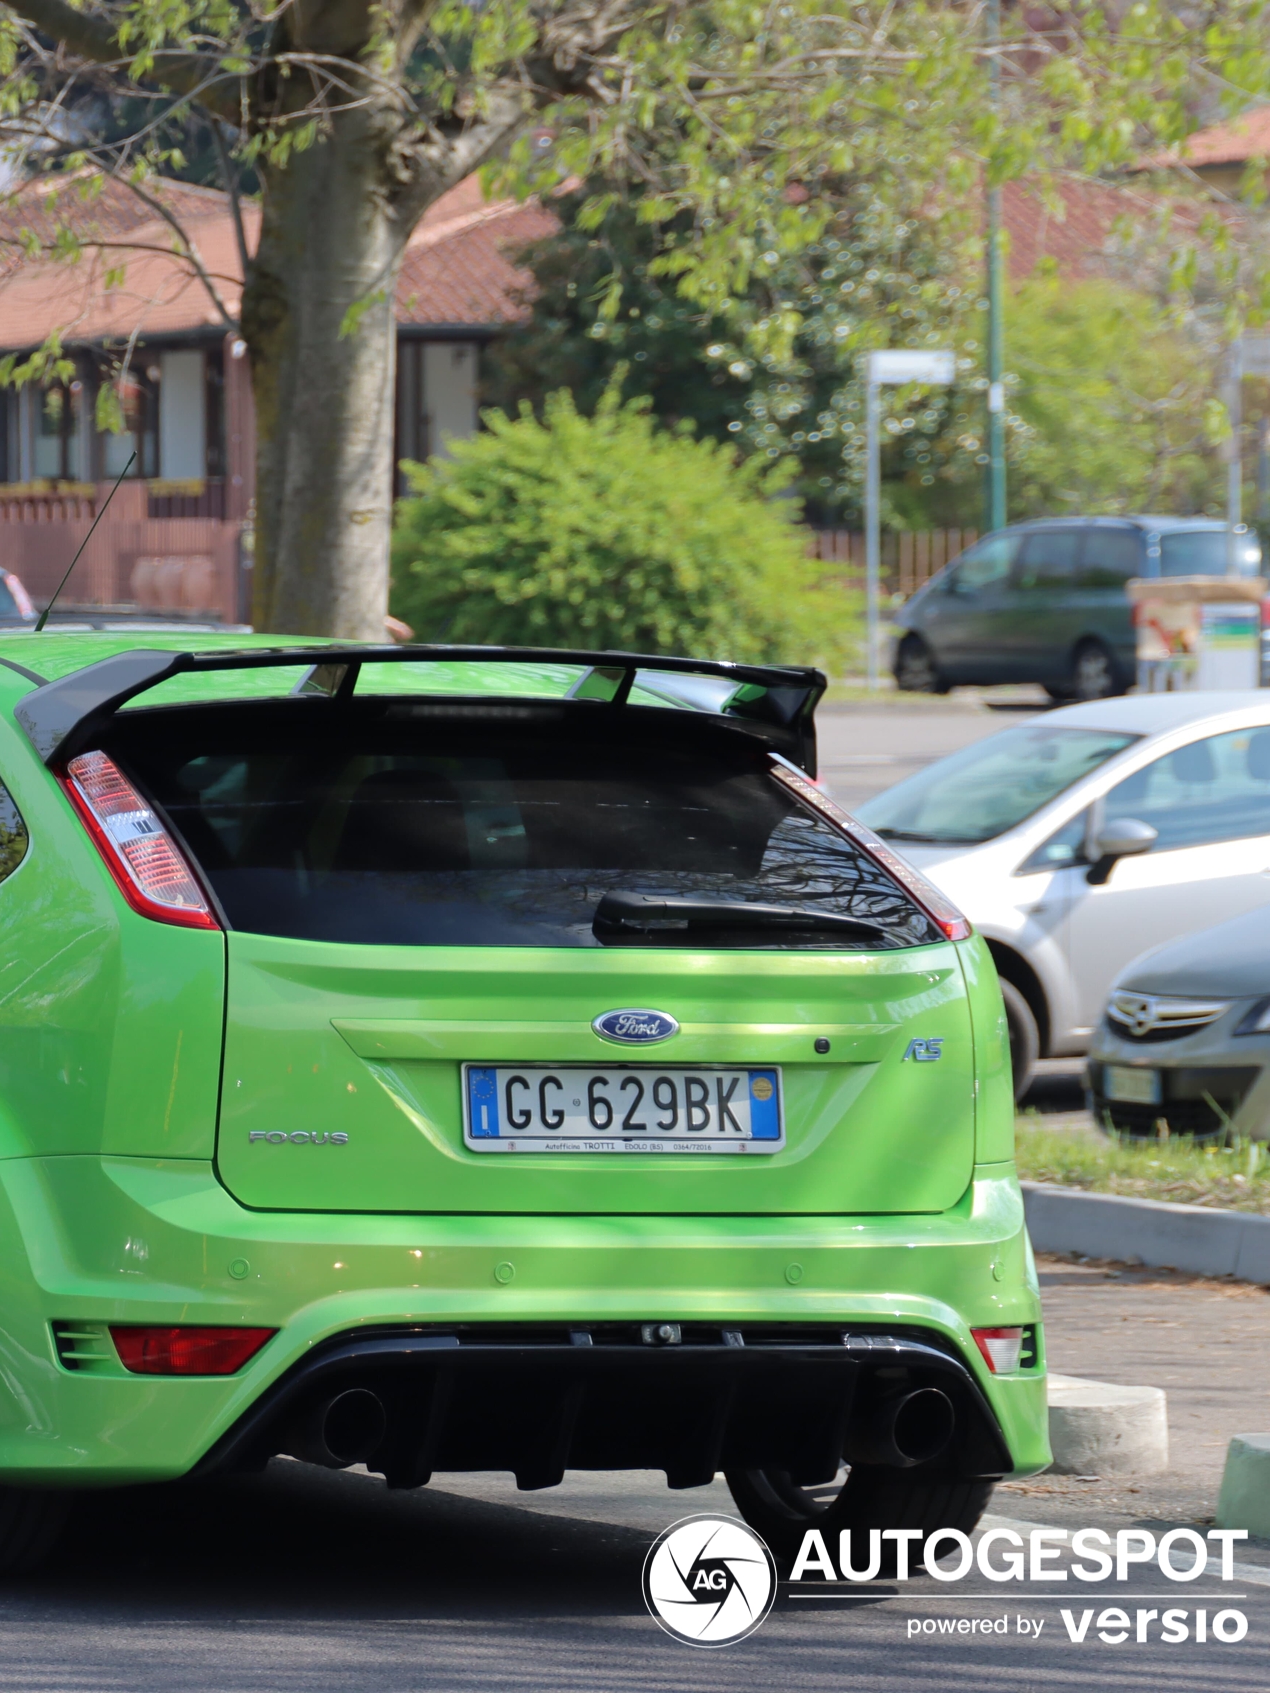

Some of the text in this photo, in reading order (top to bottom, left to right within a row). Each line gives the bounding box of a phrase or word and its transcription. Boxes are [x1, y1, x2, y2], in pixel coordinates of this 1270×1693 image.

[614, 1014, 661, 1035] Ford
[902, 1037, 945, 1062] RS
[505, 1075, 565, 1130] GG
[587, 1075, 743, 1132] 629BK
[249, 1130, 349, 1145] FOCUS
[545, 1142, 581, 1150] Autofficina
[583, 1142, 616, 1150] TROTTI
[625, 1142, 648, 1150] EDOLO
